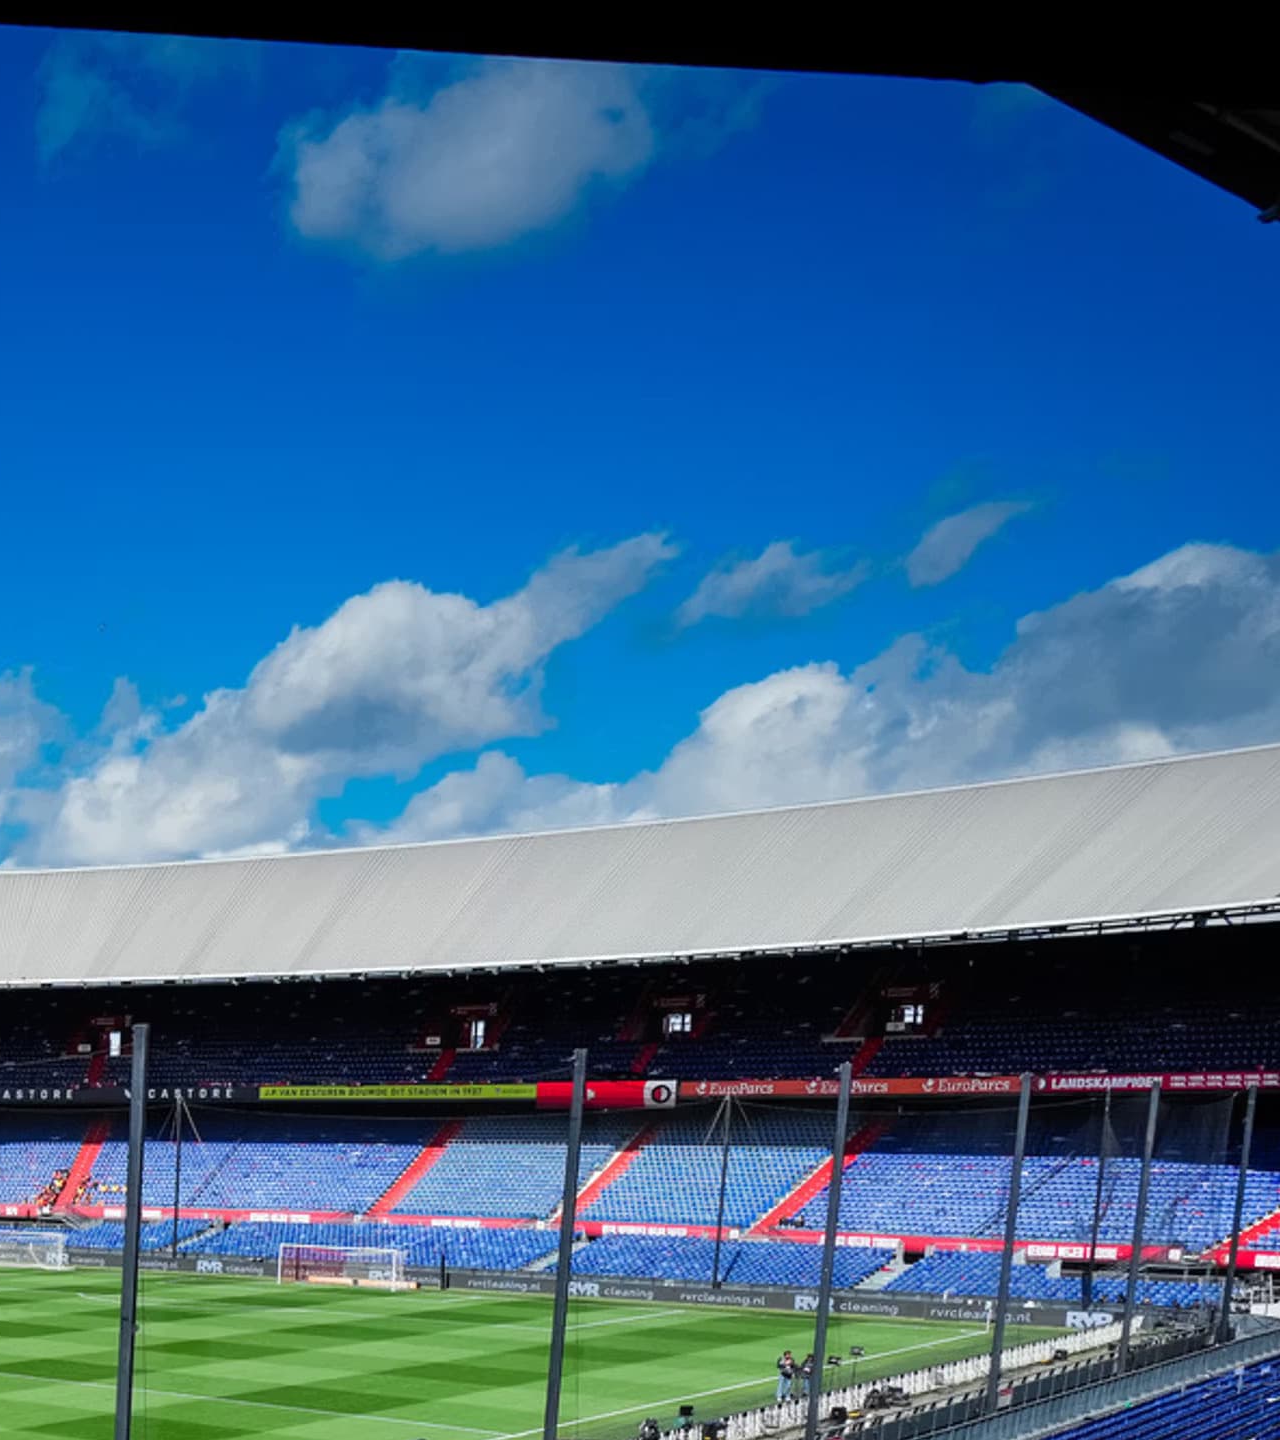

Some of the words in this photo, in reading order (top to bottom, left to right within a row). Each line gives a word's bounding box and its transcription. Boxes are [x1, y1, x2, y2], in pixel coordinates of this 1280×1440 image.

[708, 1082, 774, 1095] EuroParcs
[820, 1080, 888, 1094] EuParcs
[937, 1078, 1011, 1093] EuroParcs
[148, 1088, 234, 1100] CASTORE
[196, 1260, 223, 1273] RVR
[568, 1281, 599, 1297] RVR
[603, 1283, 654, 1299] cleaning
[680, 1291, 767, 1306] rvrcleaning.nl
[839, 1300, 899, 1316] cleaning
